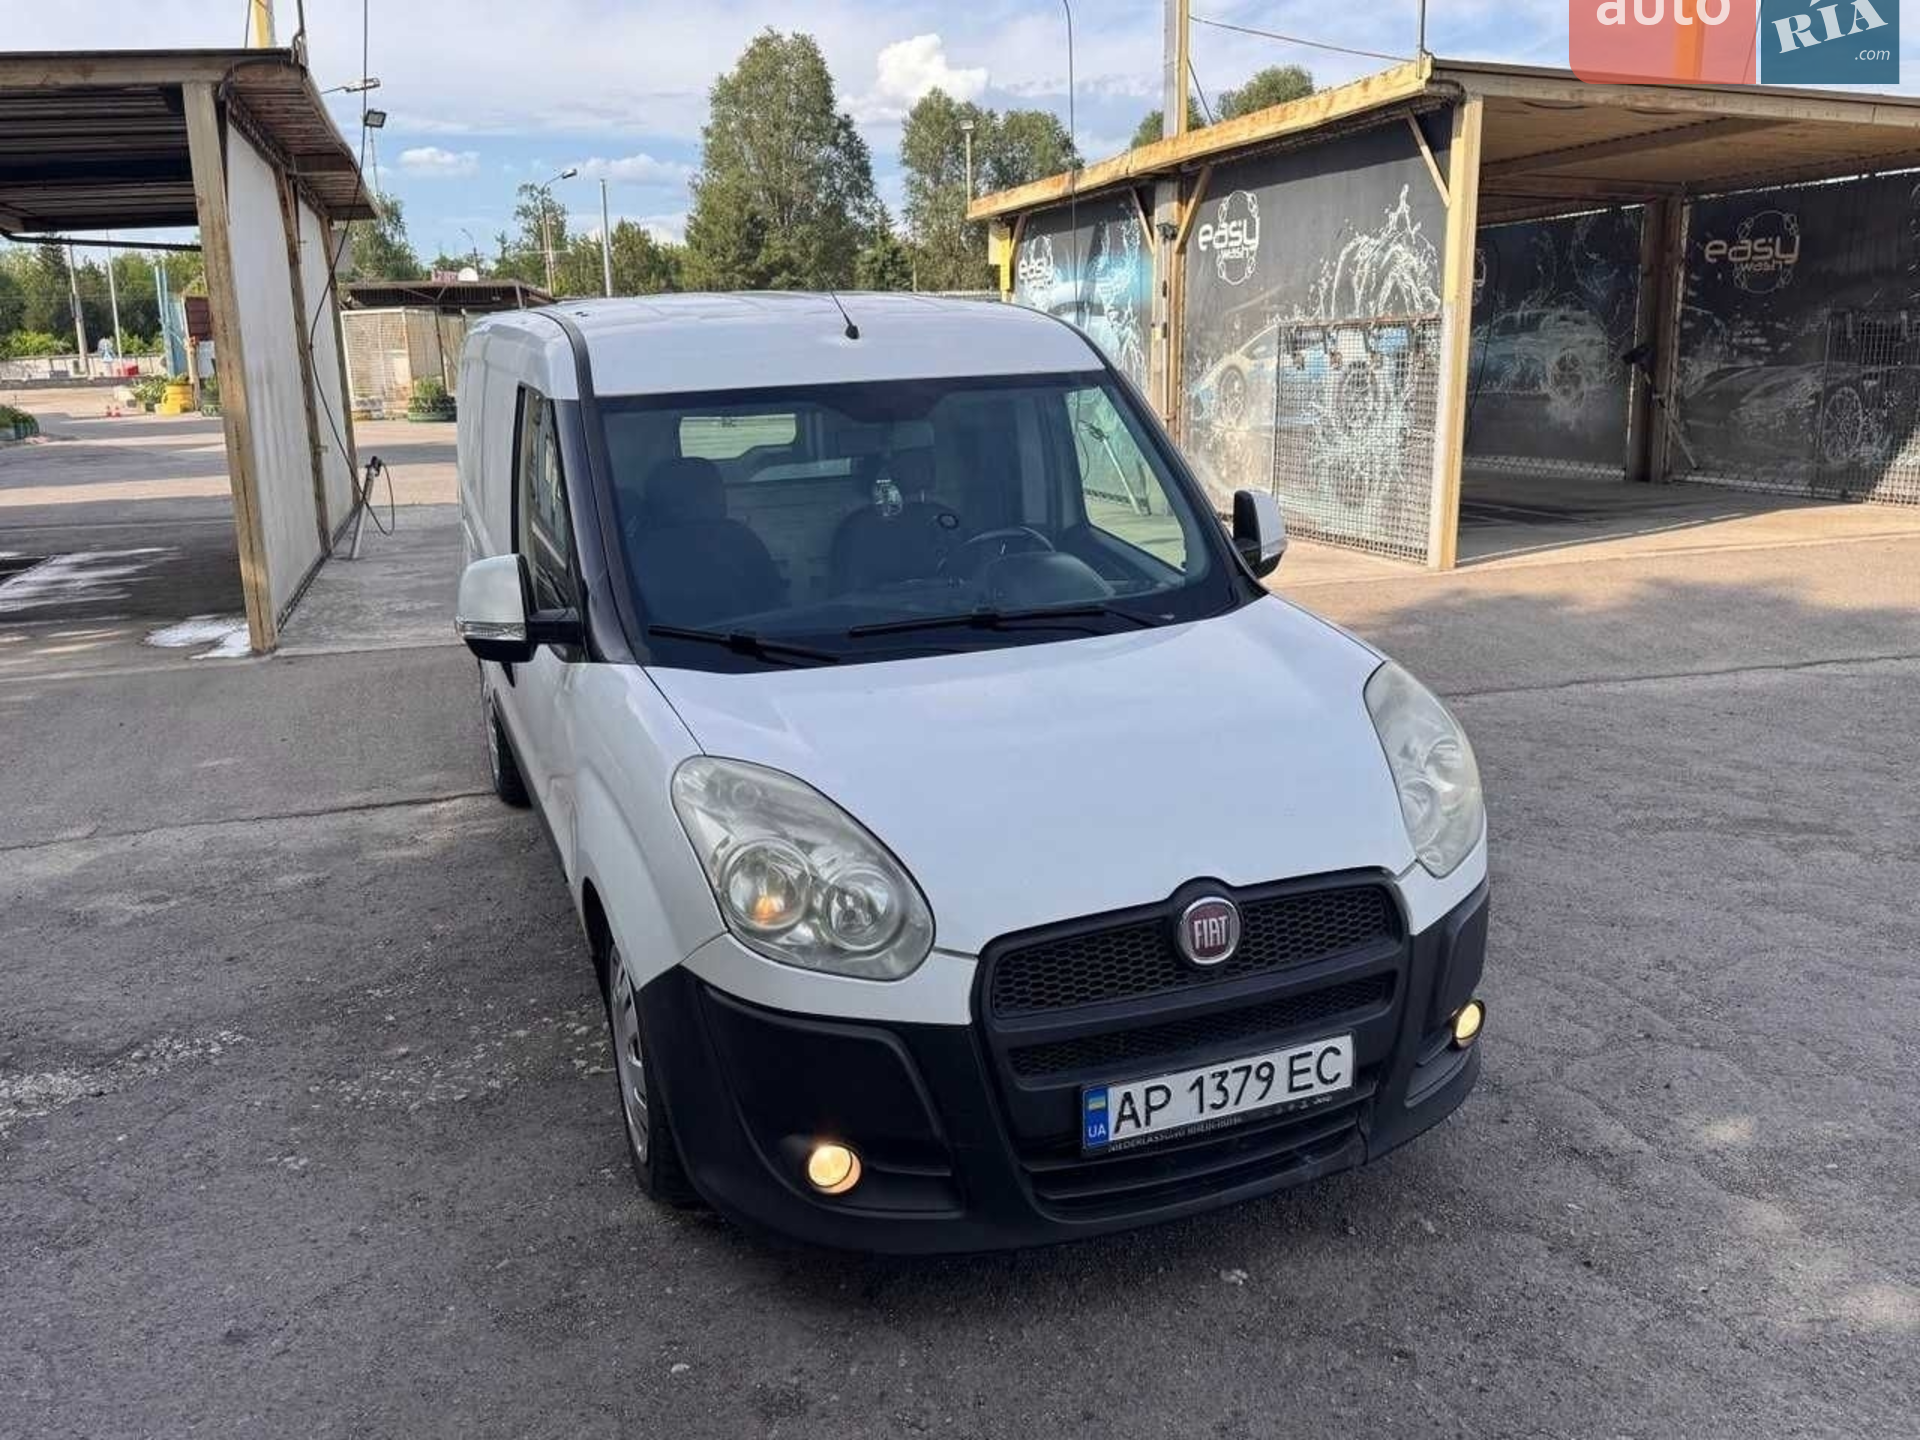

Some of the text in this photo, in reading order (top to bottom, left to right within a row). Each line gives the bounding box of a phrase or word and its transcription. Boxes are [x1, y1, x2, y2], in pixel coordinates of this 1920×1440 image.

[1198, 217, 1260, 252] easy
[1703, 234, 1800, 264] easy
[1193, 915, 1228, 950] FIAT
[1088, 1124, 1107, 1138] UA
[1113, 1084, 1172, 1135] AP
[1188, 1060, 1276, 1115] 1379
[1287, 1046, 1342, 1094] EC
